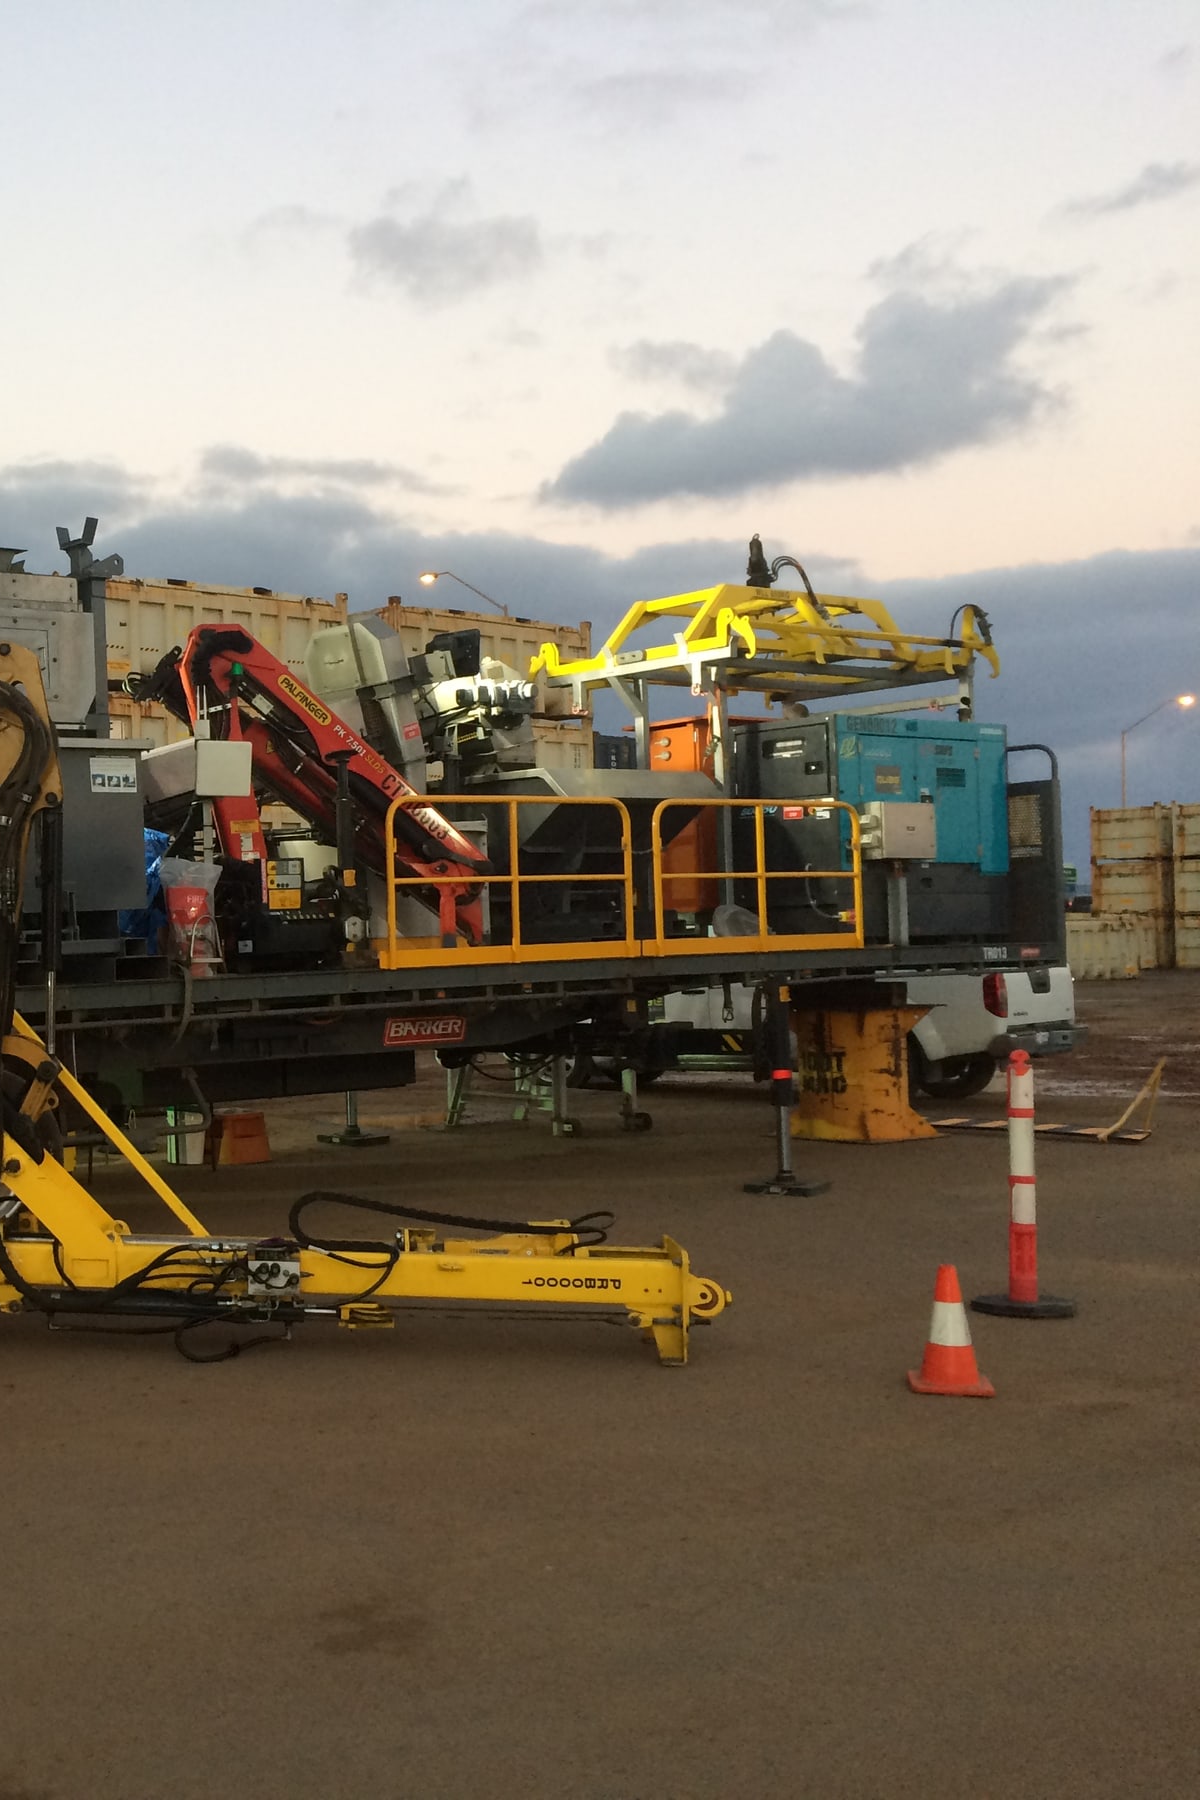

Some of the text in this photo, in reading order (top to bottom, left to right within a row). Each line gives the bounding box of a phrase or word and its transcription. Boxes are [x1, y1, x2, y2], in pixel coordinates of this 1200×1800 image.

[280, 677, 329, 723] PALFINGER
[333, 725, 347, 738] PK
[346, 736, 367, 757] 7.501
[390, 1019, 462, 1037] BARKER
